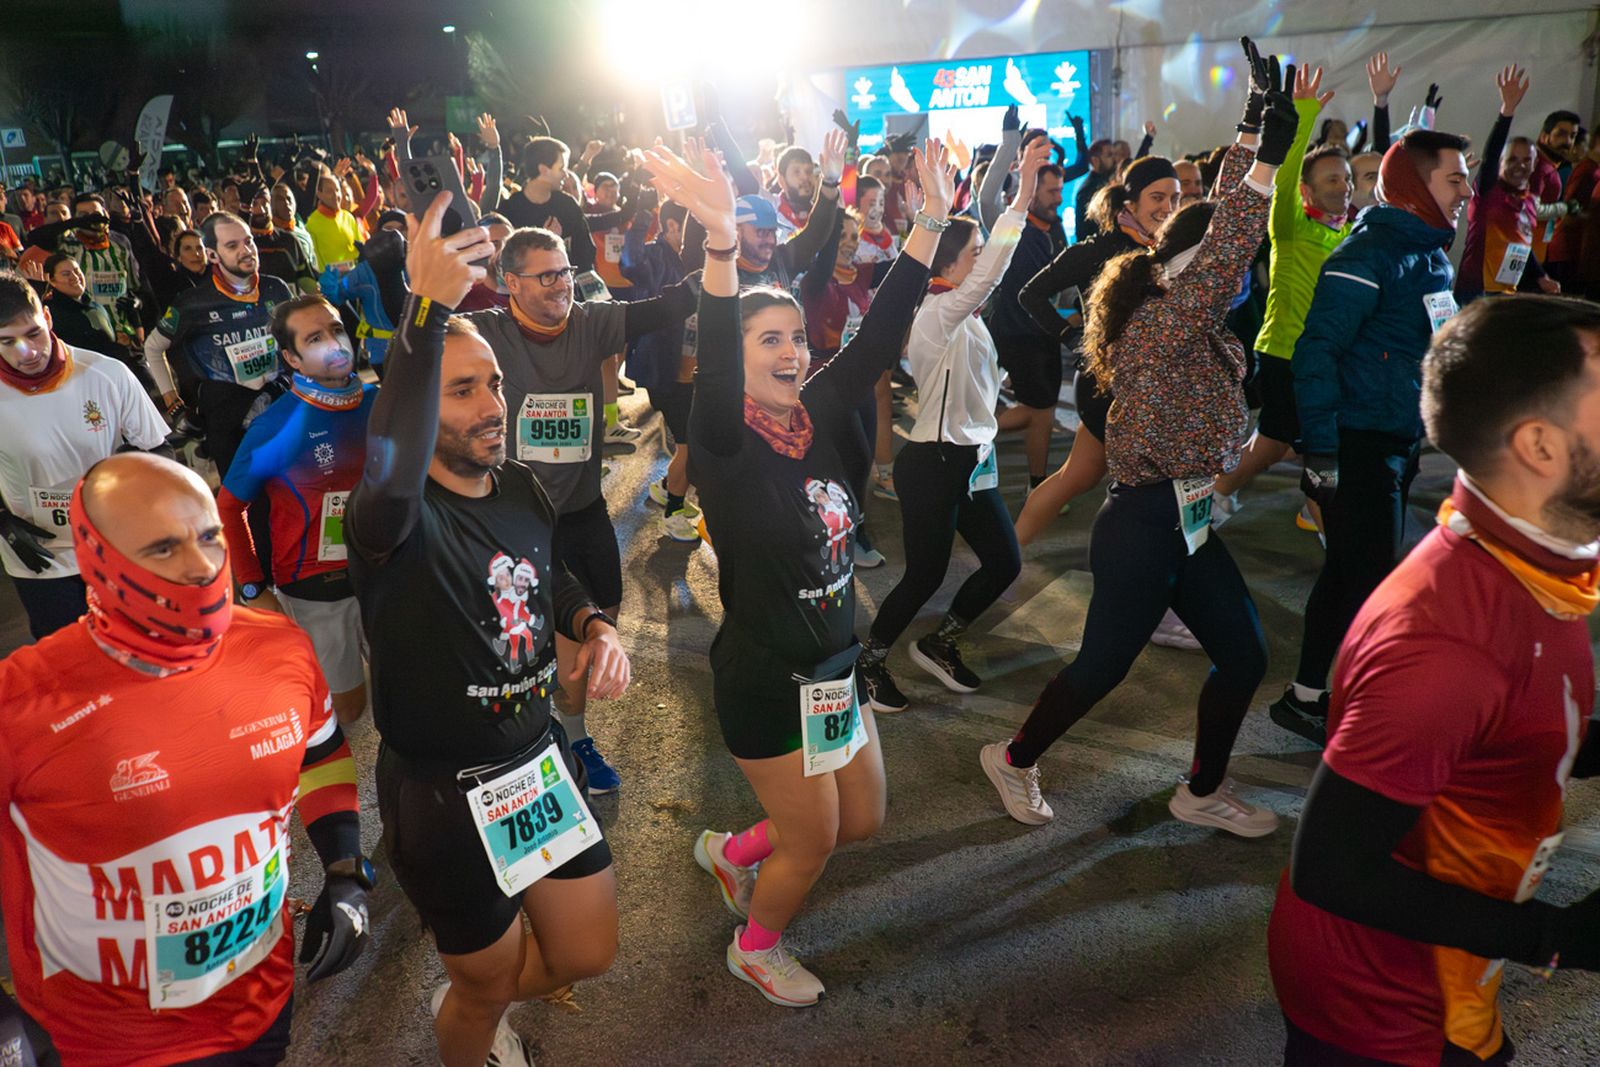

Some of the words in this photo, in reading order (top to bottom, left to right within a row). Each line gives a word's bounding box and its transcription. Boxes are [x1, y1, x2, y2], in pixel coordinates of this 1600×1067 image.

[933, 68, 955, 88] 43
[955, 64, 992, 86] SAN
[212, 331, 241, 346] SAN
[526, 410, 541, 418] SAN
[535, 401, 558, 409] NOCHE
[531, 419, 581, 440] 9595
[798, 588, 823, 599] San
[467, 684, 499, 697] San
[501, 676, 537, 696] Antón
[813, 703, 834, 714] SAN
[495, 781, 526, 802] NOCHE
[487, 802, 510, 822] SAN
[500, 791, 564, 850] 7839
[187, 892, 234, 916] NOCHE
[236, 879, 253, 895] DE
[167, 917, 202, 935] SAN
[184, 892, 271, 966] 8224
